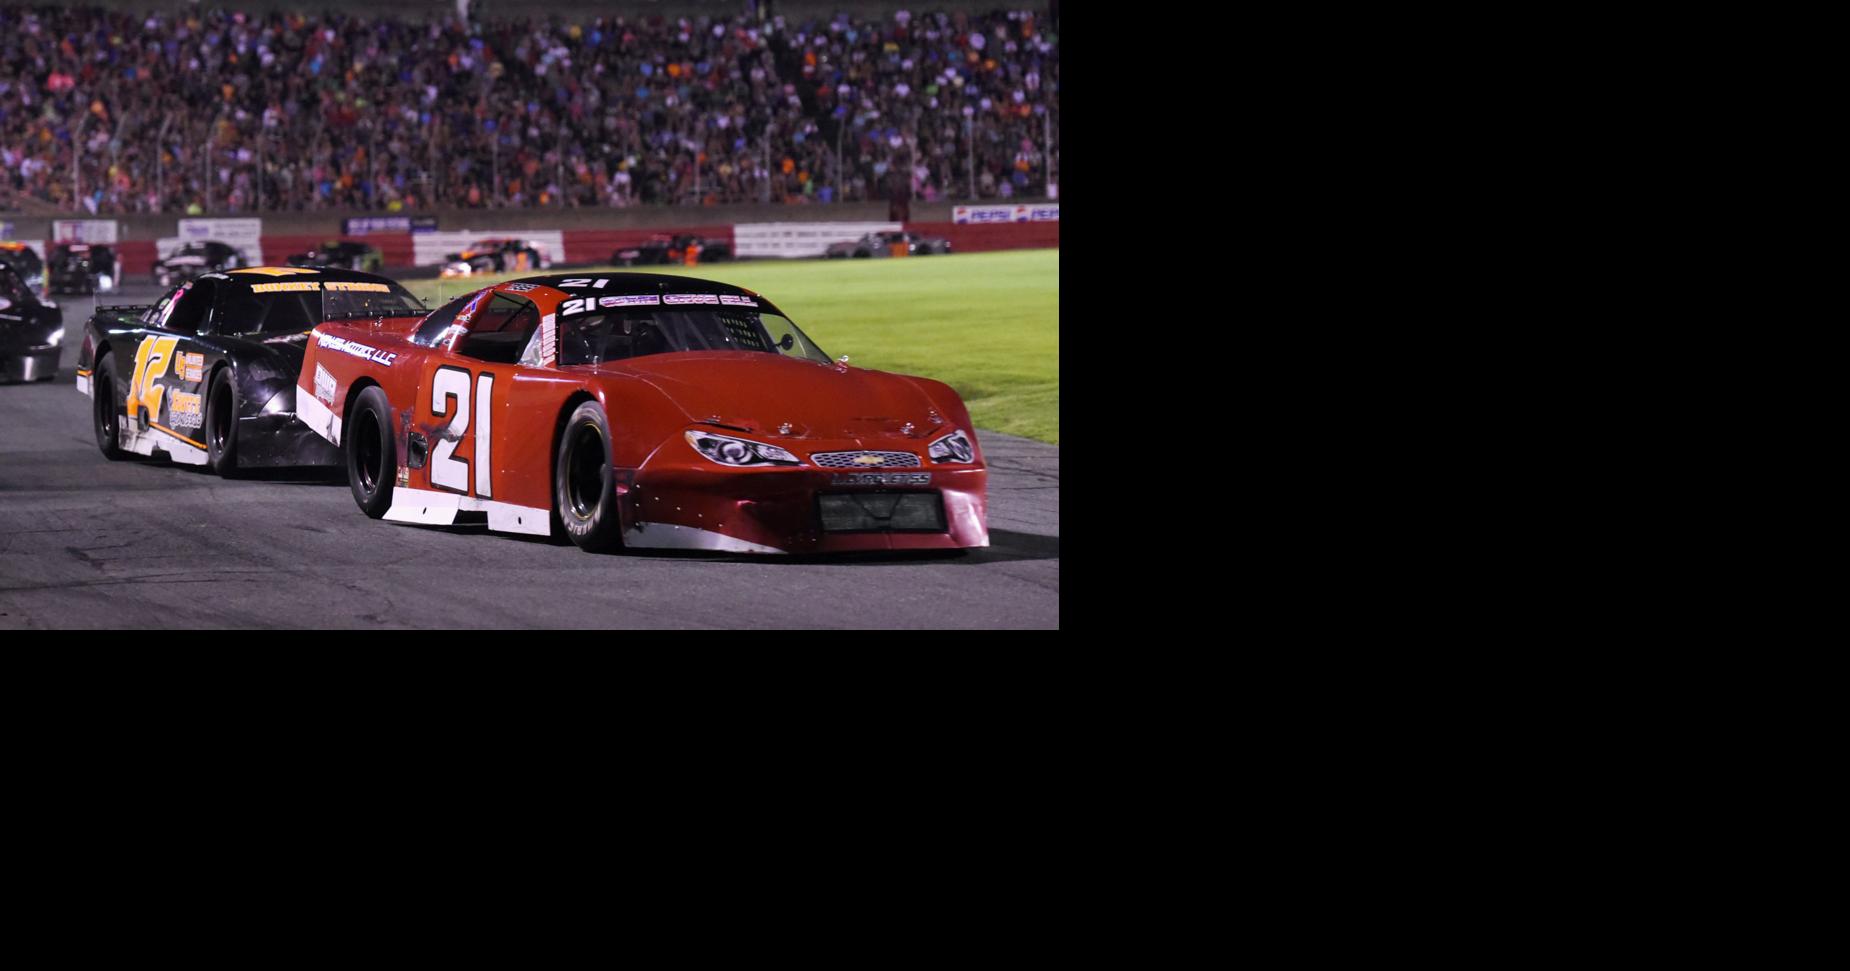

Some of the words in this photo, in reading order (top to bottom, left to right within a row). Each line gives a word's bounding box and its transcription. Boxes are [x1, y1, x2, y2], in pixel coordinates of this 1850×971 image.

[971, 209, 1011, 220] PEPSI
[558, 278, 610, 289] 21
[562, 297, 597, 316] 21
[371, 349, 397, 366] LLC
[127, 334, 180, 423] 12
[430, 364, 495, 500] 21
